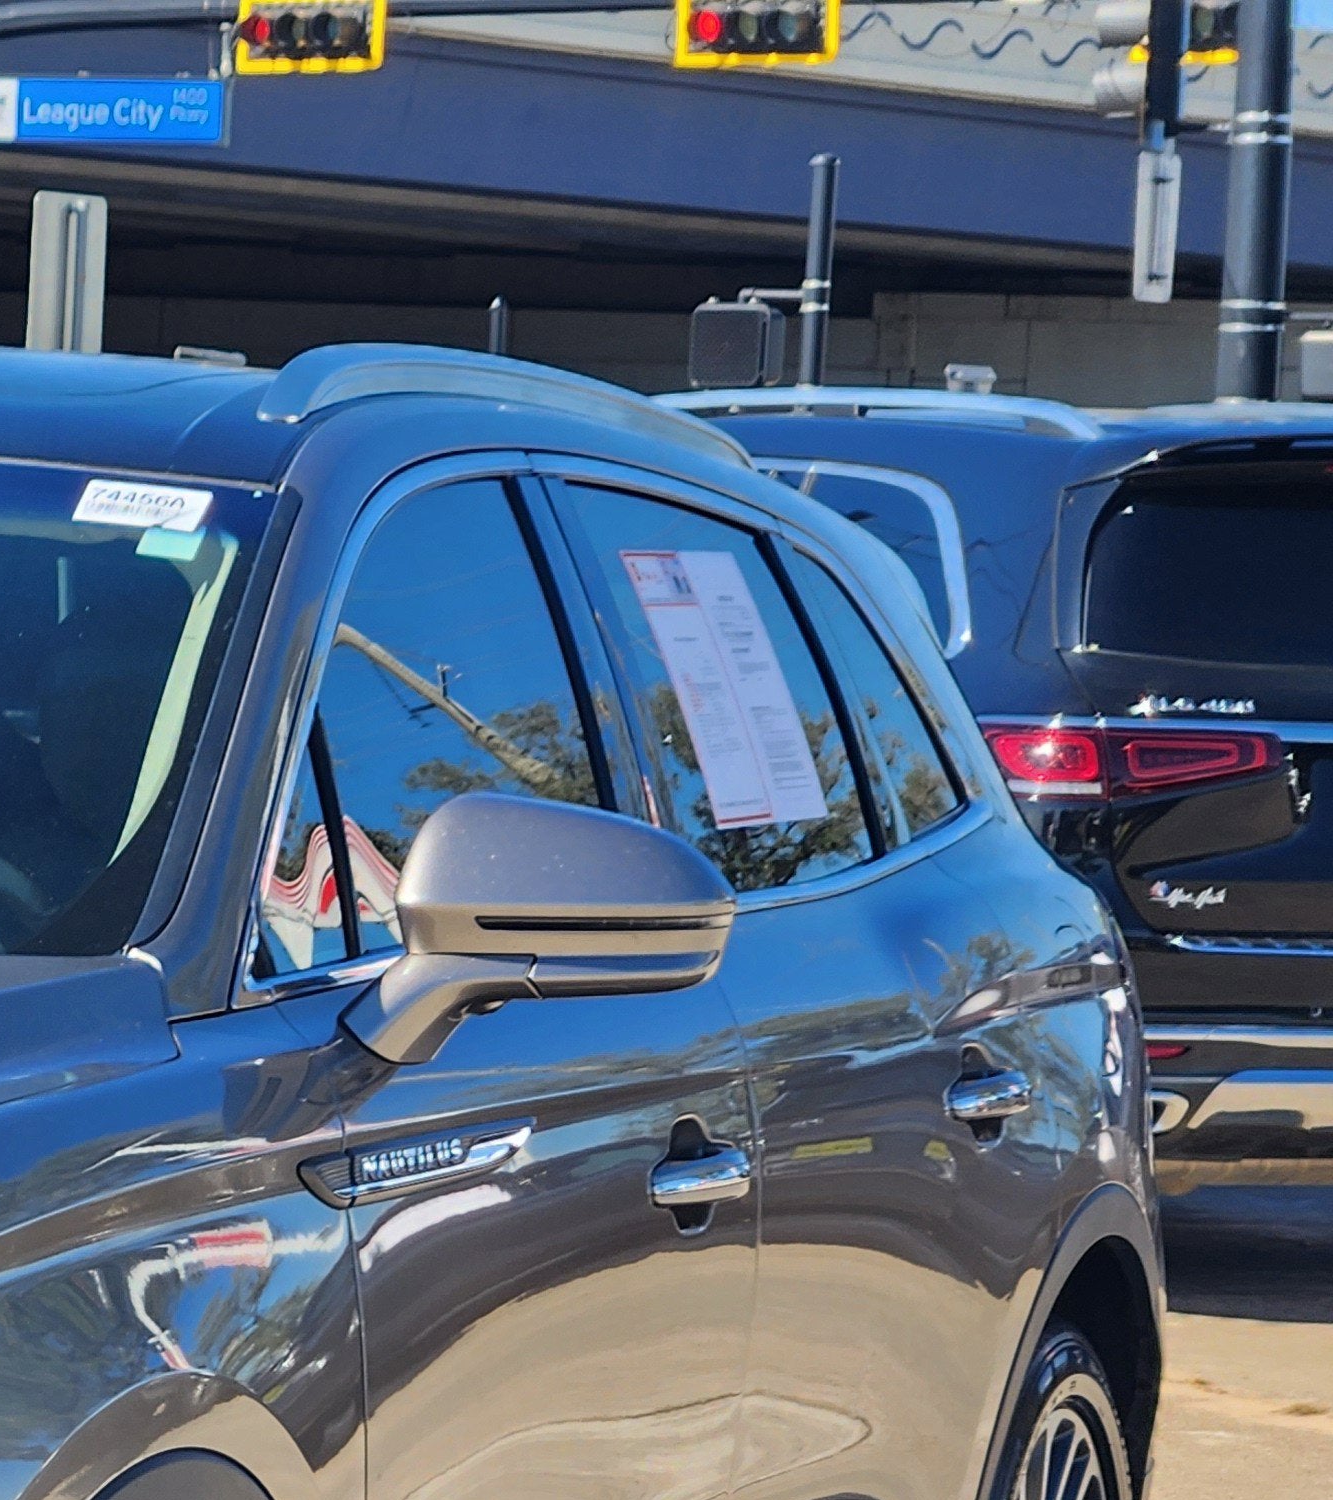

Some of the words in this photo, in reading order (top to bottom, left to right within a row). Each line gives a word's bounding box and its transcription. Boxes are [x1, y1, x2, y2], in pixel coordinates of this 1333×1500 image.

[22, 97, 110, 132] League
[113, 98, 164, 131] City
[361, 1138, 465, 1180] NAUTILUS
